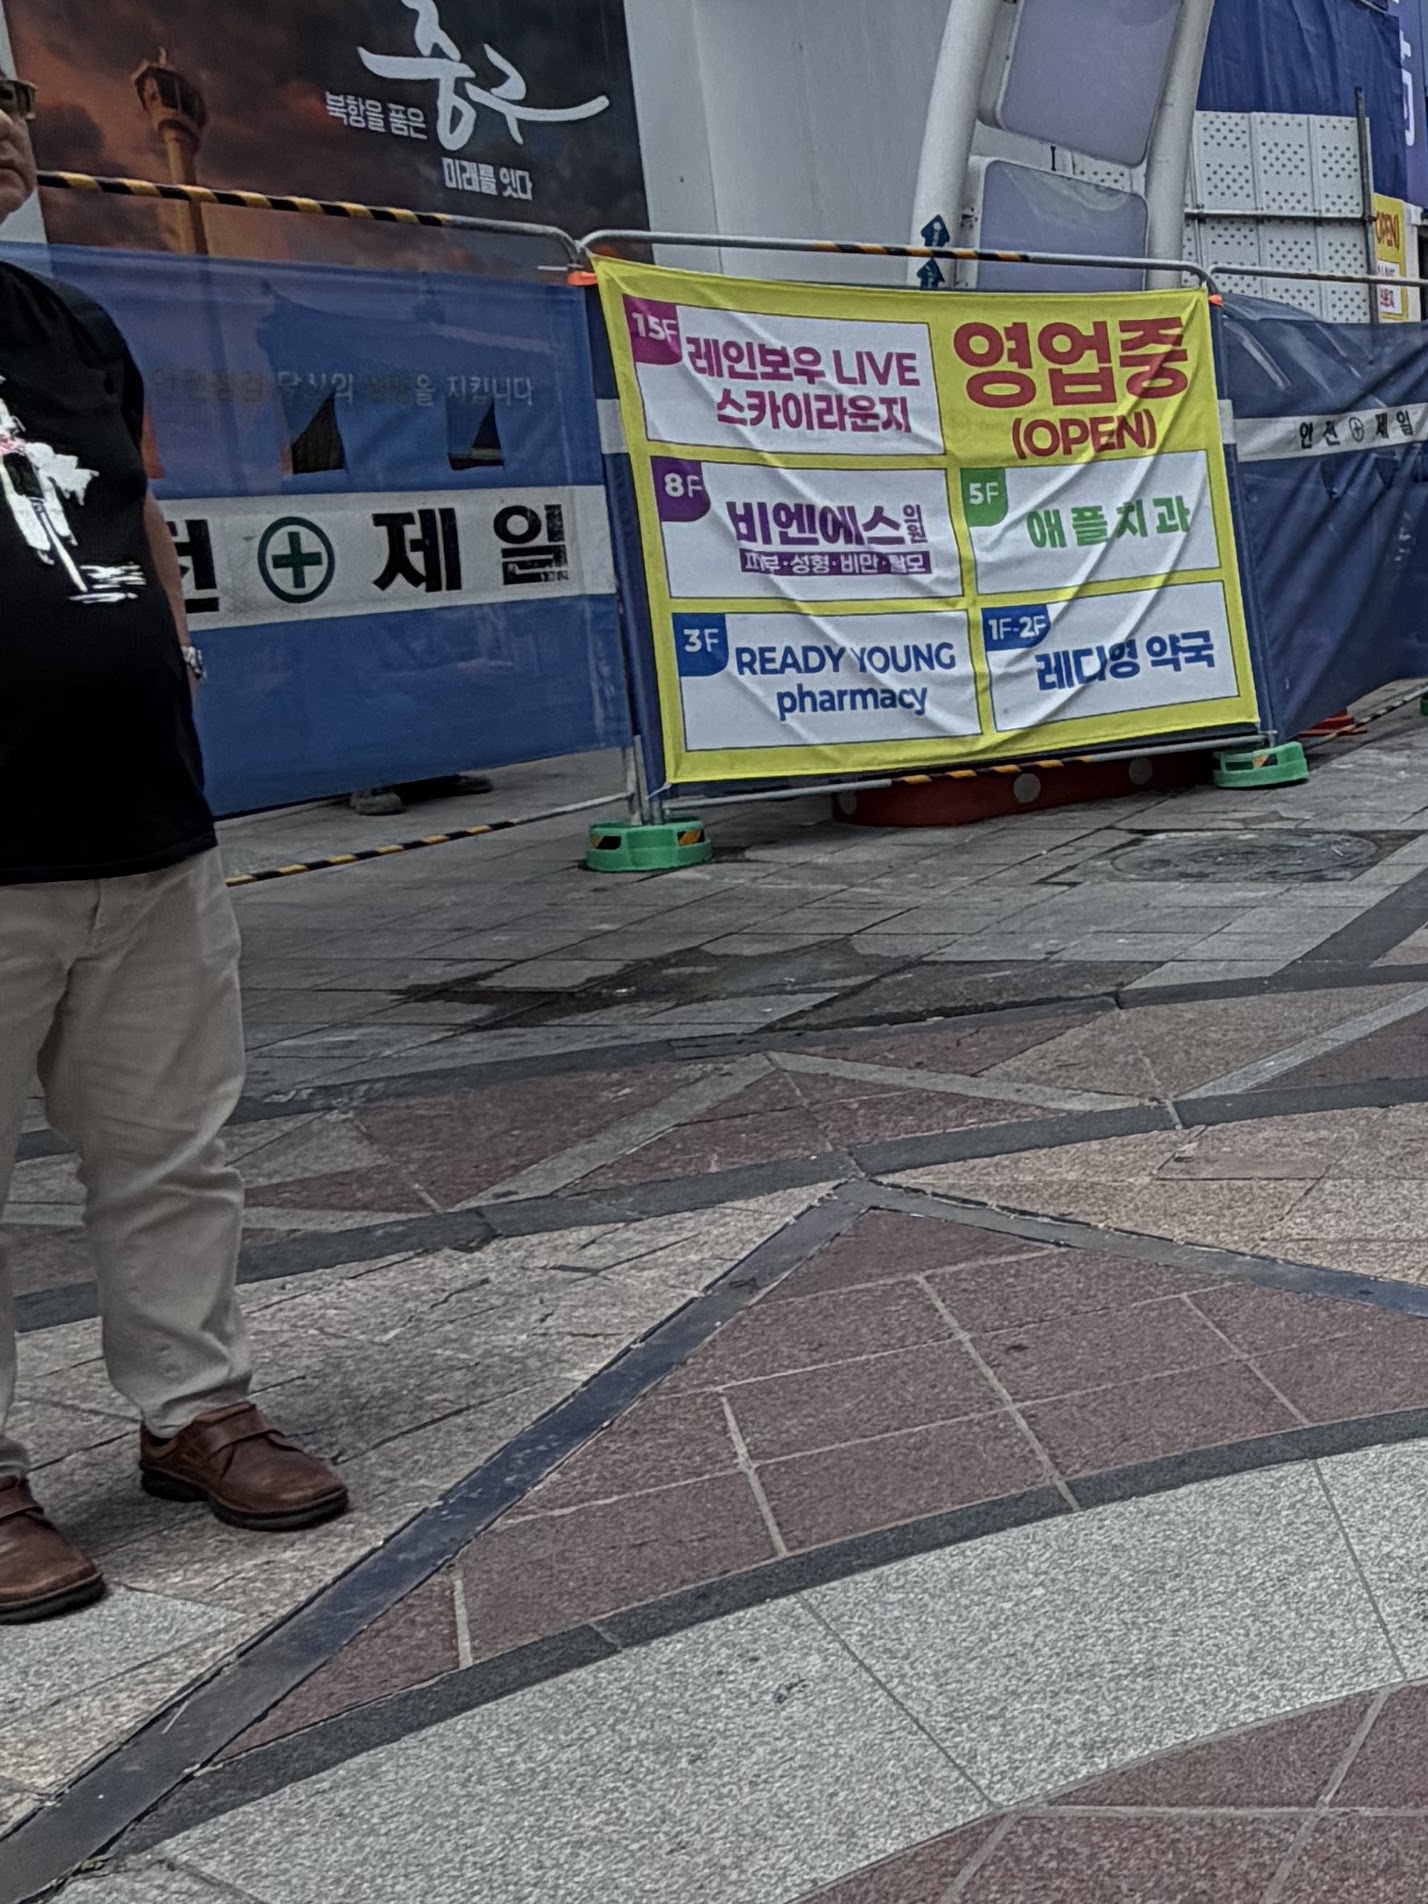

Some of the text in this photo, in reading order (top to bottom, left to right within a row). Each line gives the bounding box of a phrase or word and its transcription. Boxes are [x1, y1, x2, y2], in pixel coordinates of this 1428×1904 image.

[325, 91, 428, 140] 북항을 품은
[441, 157, 533, 201] 미래를 잇다
[632, 312, 679, 343] 15F
[685, 336, 921, 387] 레인보우 LIVE
[953, 316, 1190, 409] 영업중
[716, 388, 912, 434] 스카이라운지
[1011, 408, 1158, 460] (OPEN)
[663, 473, 704, 499] 8F
[968, 481, 999, 505] 5F
[726, 500, 929, 546] 비엔에스 의원
[1026, 495, 1191, 549] 애플치과
[683, 628, 720, 653] 3F
[987, 614, 1050, 641] 1F-2F
[735, 642, 956, 676] READY YOUNG
[1035, 630, 1216, 692] 레디영 약국
[776, 683, 929, 722] pharmacy
